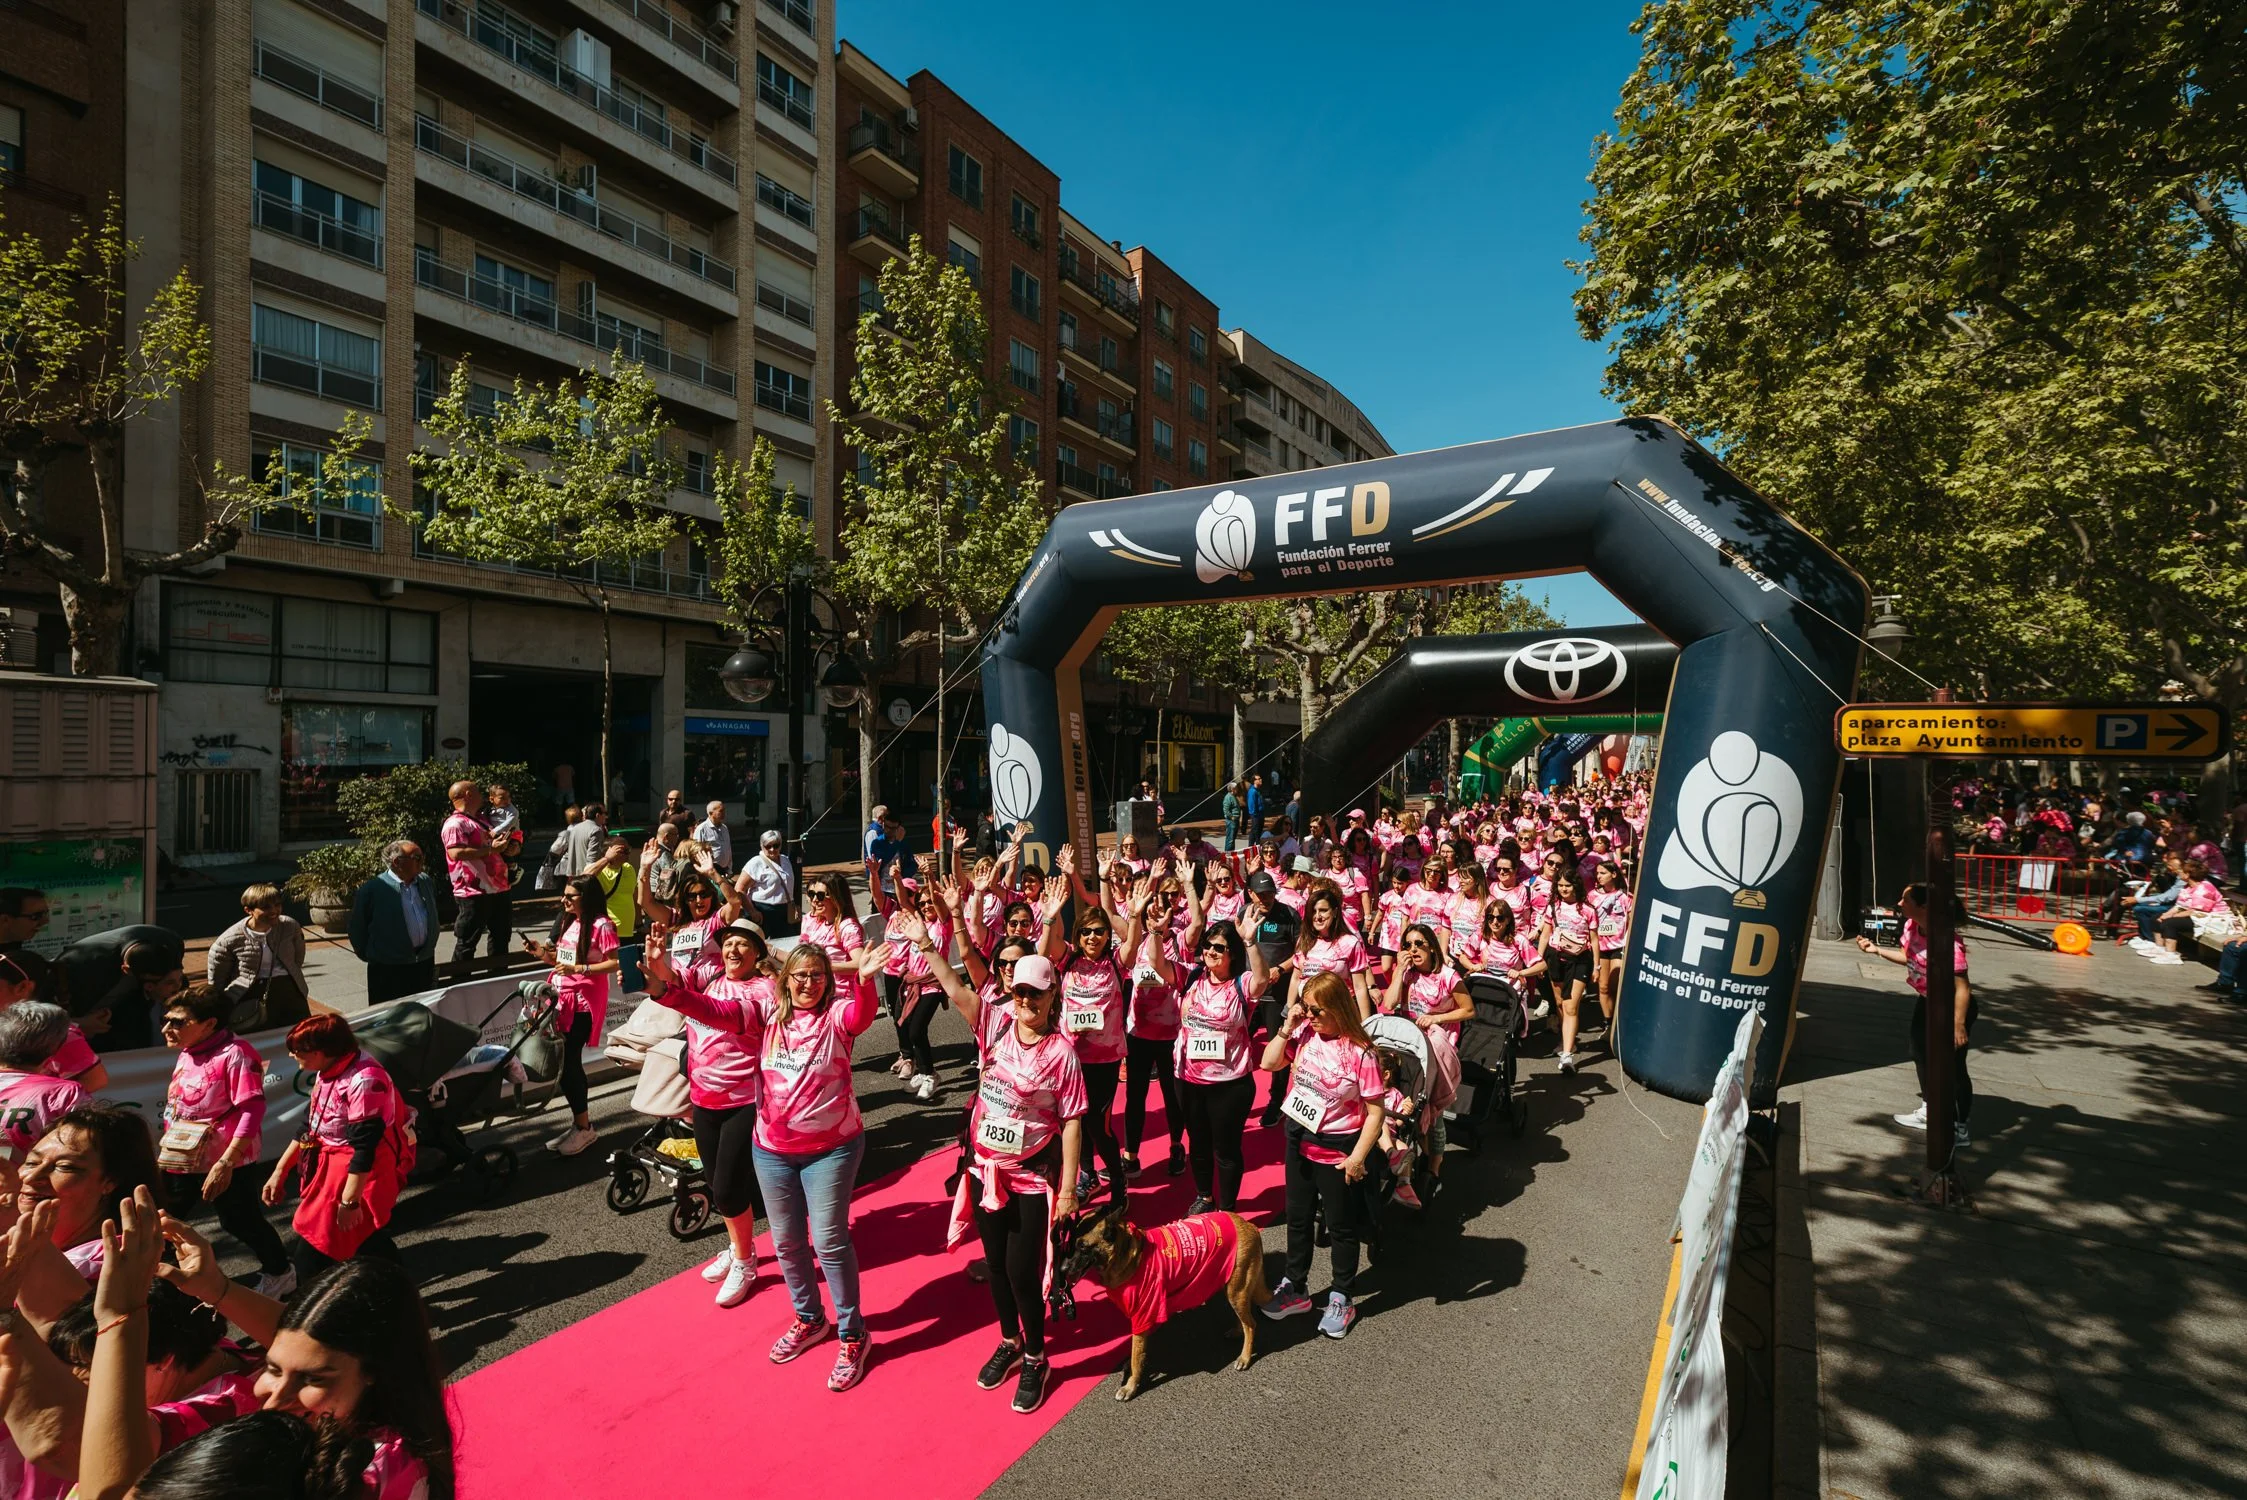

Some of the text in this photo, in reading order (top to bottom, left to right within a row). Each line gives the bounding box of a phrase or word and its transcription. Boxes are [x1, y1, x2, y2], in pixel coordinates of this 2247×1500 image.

[1274, 481, 1391, 546] FFD
[1277, 541, 1391, 564] Fundación Ferrer
[1281, 555, 1395, 578] para el Deporte
[1172, 714, 1182, 739] El
[1848, 715, 2138, 747] aparcamiento: P
[1847, 733, 2083, 749] plaza Ayuntamiento
[676, 934, 697, 945] 7306
[1644, 898, 1780, 977] FFD
[560, 949, 573, 961] 7305
[1140, 970, 1156, 981] 426
[1641, 953, 1770, 996] Fundación Ferrer
[1638, 969, 1766, 1011] para el Deporte
[483, 1022, 516, 1035] asociac
[1073, 1012, 1097, 1025] 7012
[1193, 1039, 1217, 1052] 7011
[984, 1071, 1013, 1089] Carrera
[1297, 1065, 1321, 1082] Carrera
[982, 1080, 1002, 1095] por la
[981, 1091, 1029, 1113] investigación
[1291, 1096, 1317, 1121] 1068
[984, 1124, 1016, 1144] 1830
